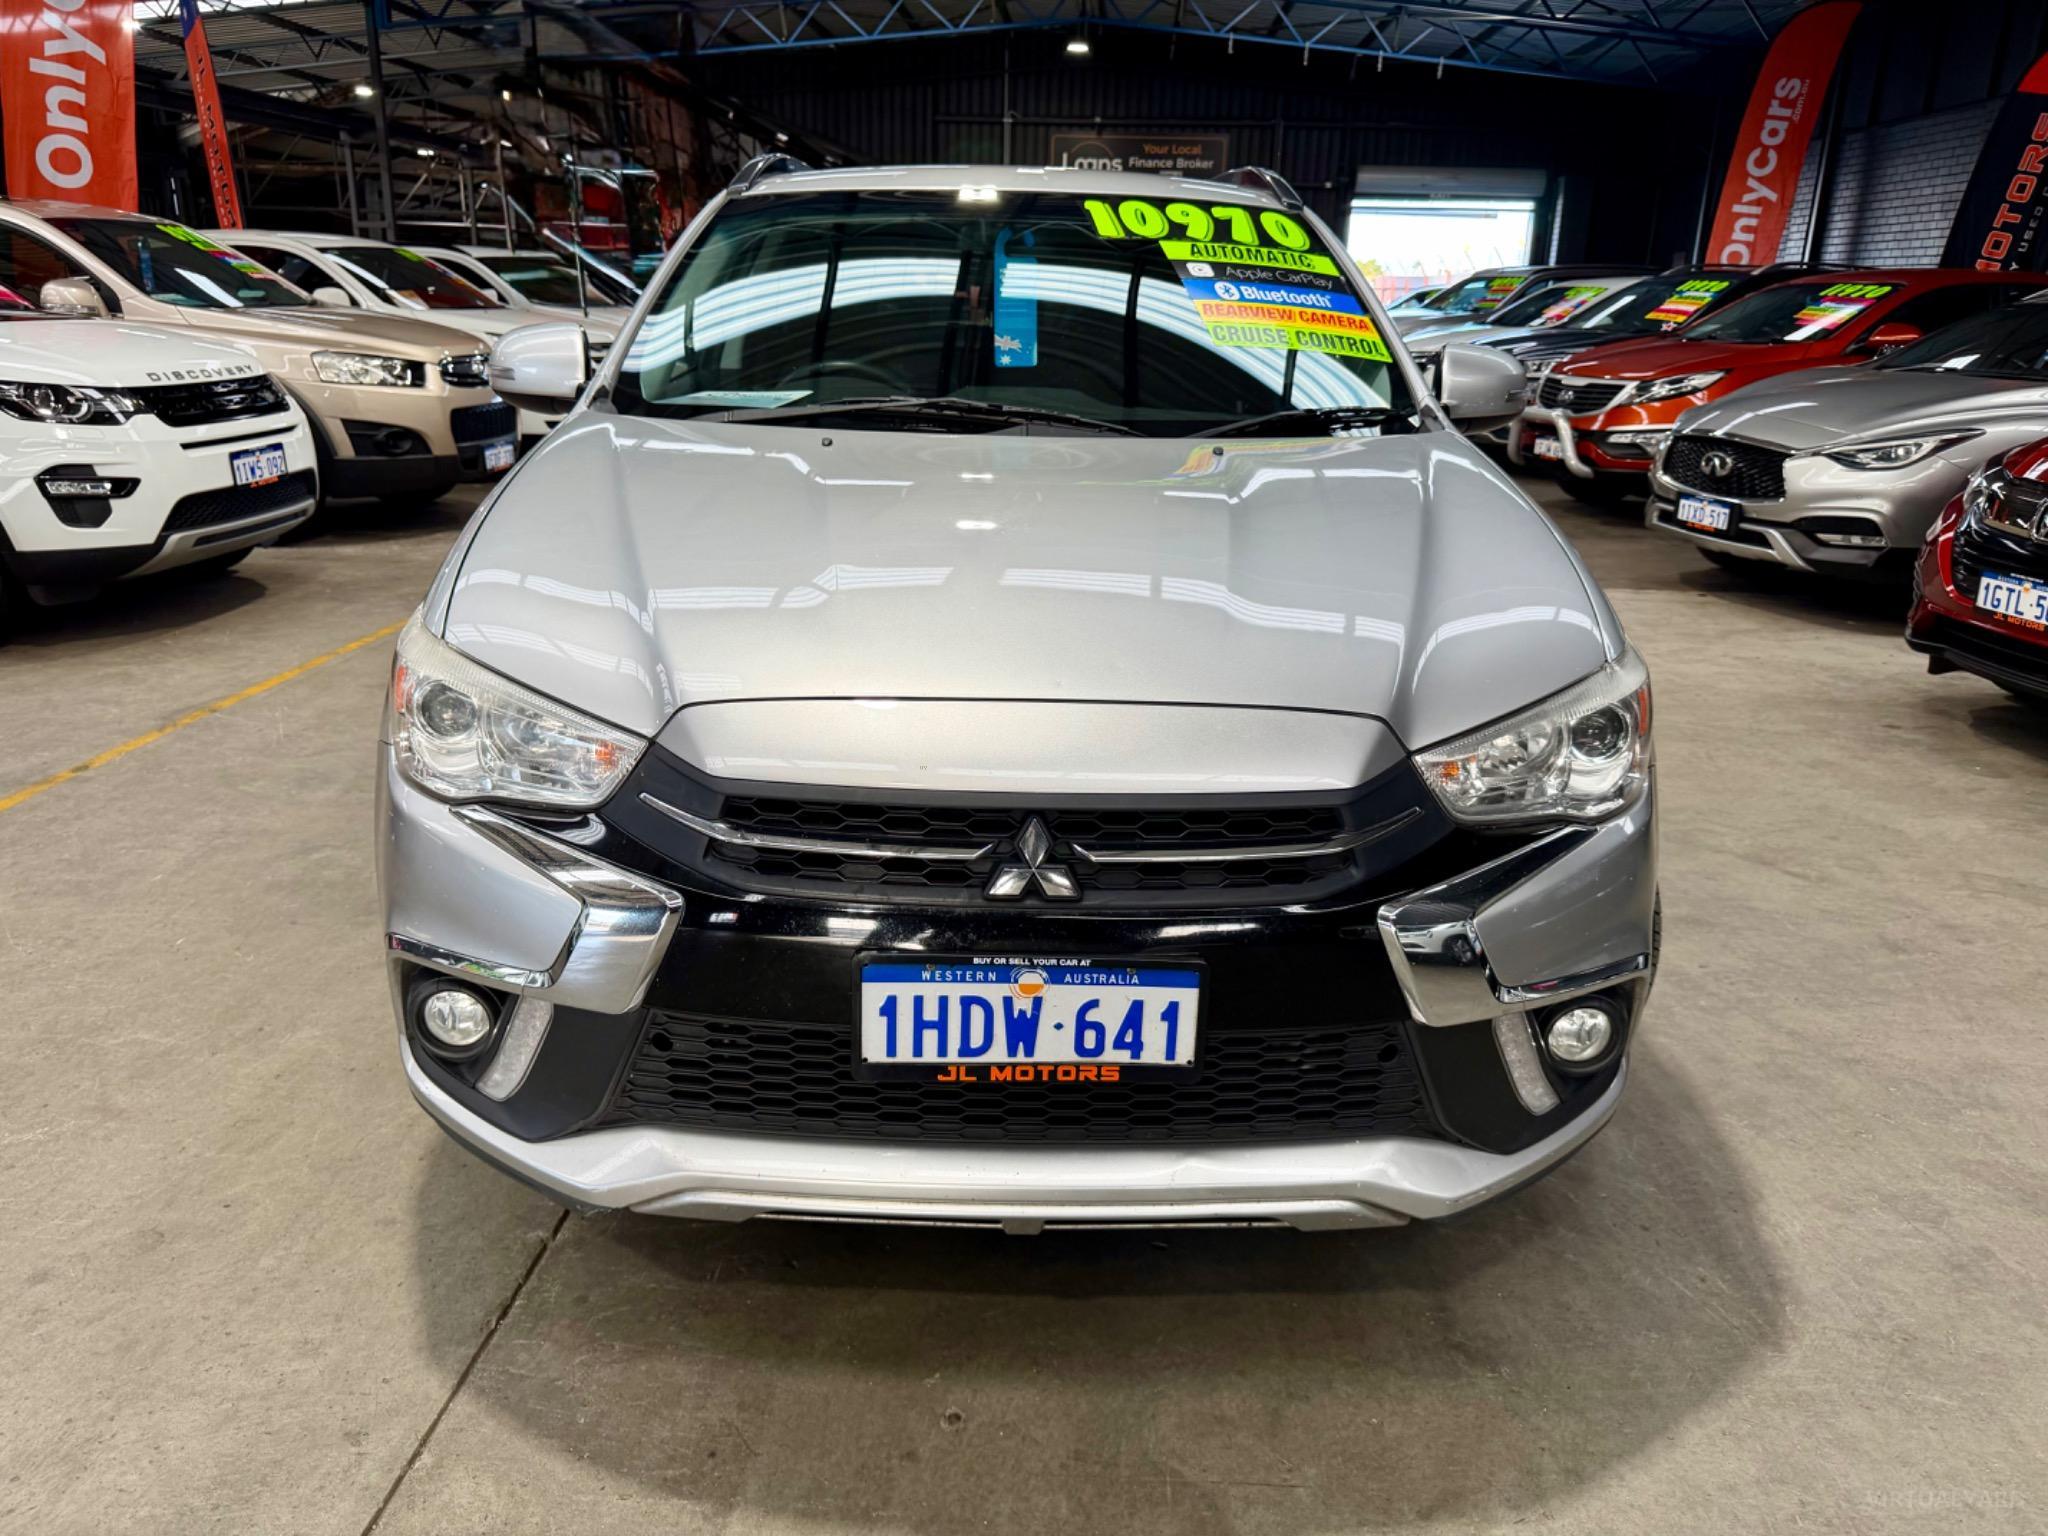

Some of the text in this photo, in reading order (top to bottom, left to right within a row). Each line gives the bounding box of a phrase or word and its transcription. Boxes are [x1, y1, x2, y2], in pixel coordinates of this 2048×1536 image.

[1142, 144, 1202, 154] Your Local
[1128, 157, 1214, 169] Finance Broker
[1720, 77, 1802, 265] OnlyCars
[1084, 199, 1310, 250] 10970
[1190, 242, 1315, 270] AUTOMATIC
[1225, 266, 1333, 289] Apple CarPlay
[1203, 304, 1370, 331] REARVIEW CAMERA
[1212, 326, 1385, 357] CRUISE CONTROL
[146, 365, 254, 382] DISCOVERY
[973, 957, 992, 965] BUY
[993, 957, 1007, 965] OR
[1008, 958, 1031, 966] SELL
[1033, 958, 1058, 966] YOUR
[1079, 959, 1092, 967] AT
[921, 970, 1140, 985] WESTERN AUSTRALIA
[937, 1065, 1120, 1082] JL MOTORS
